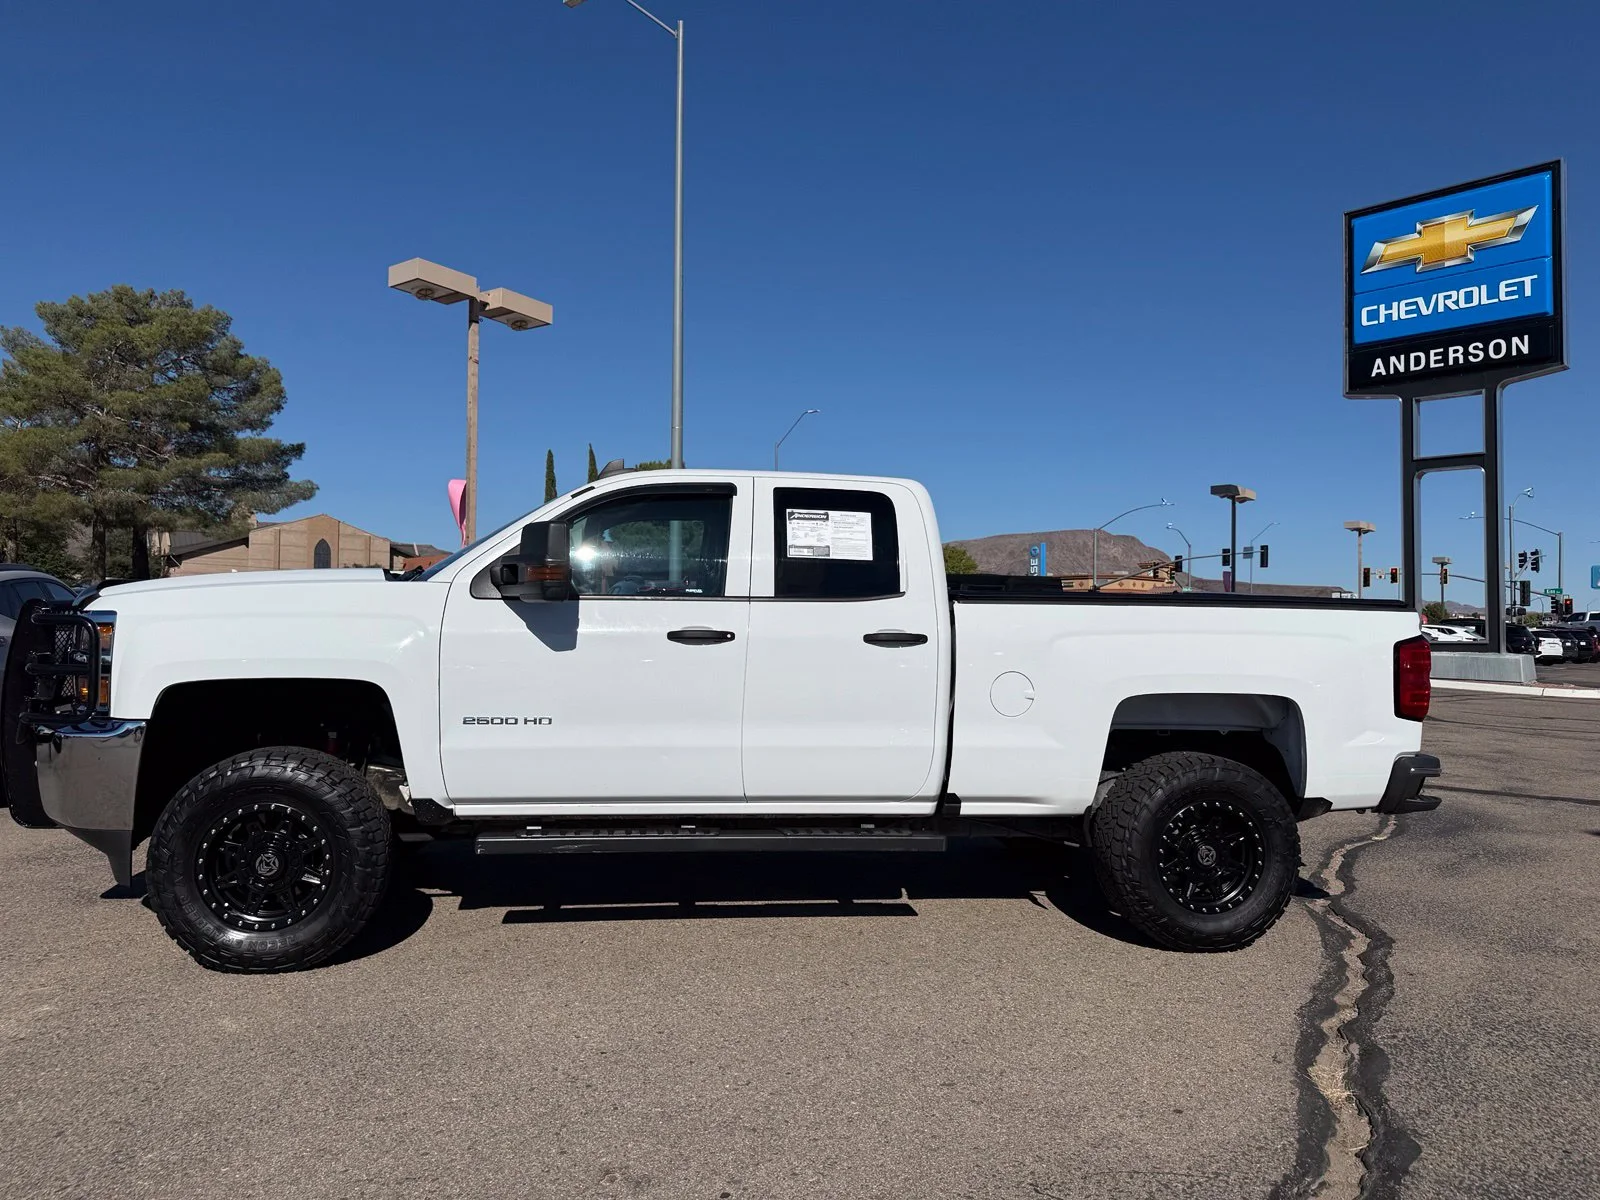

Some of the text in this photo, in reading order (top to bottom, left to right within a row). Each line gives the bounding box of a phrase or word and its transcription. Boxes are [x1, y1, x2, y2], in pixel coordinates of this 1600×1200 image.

[1361, 274, 1538, 326] CHEVROLET
[1371, 335, 1529, 377] ANDERSON
[462, 716, 552, 725] 2500 HD
